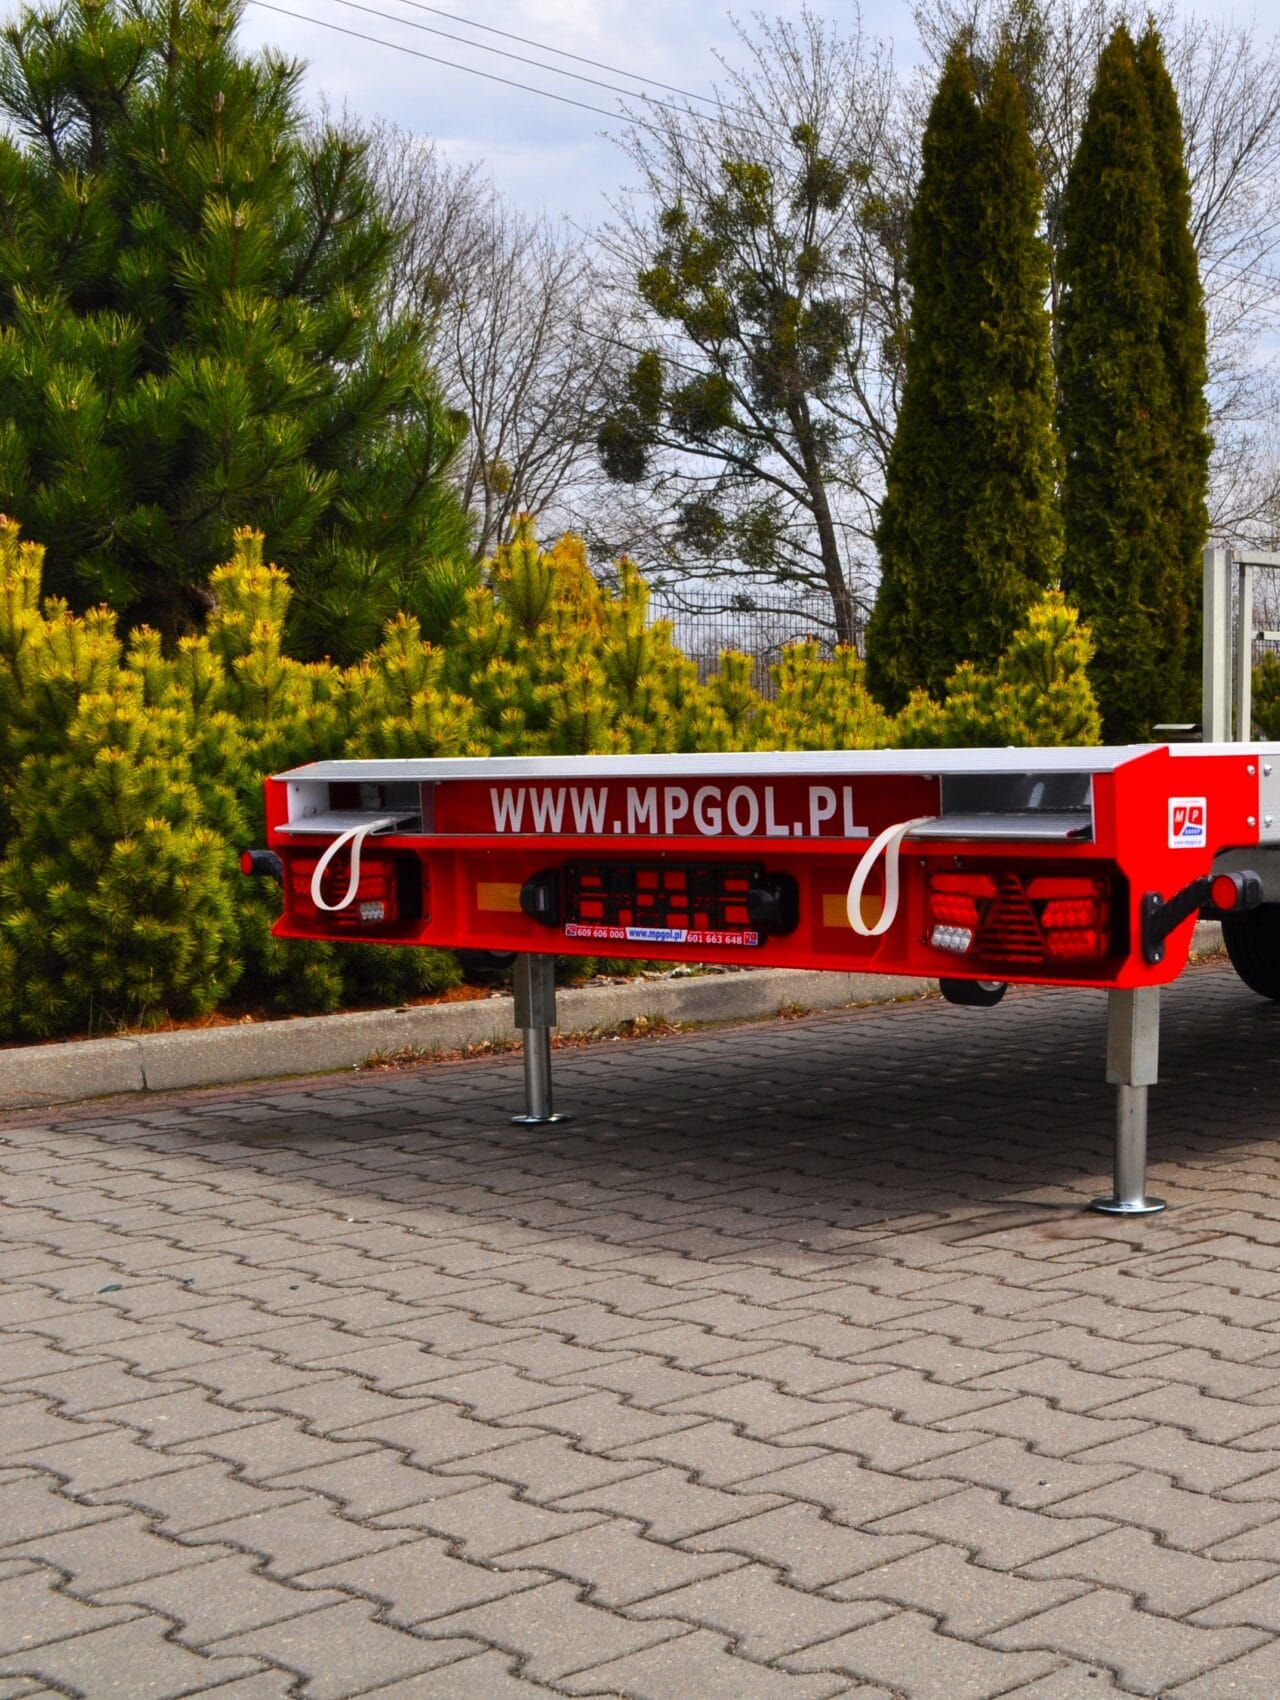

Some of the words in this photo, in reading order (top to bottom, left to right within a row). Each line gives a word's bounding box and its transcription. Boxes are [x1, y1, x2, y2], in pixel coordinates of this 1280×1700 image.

[490, 785, 869, 838] WWW.MPGOL.PL
[577, 928, 592, 938] 609
[593, 929, 608, 939] 606
[609, 930, 625, 939] 000
[628, 929, 683, 942] www.mpgol.pl
[687, 933, 704, 943] 601
[705, 935, 723, 944] 663
[725, 935, 743, 945] 648
